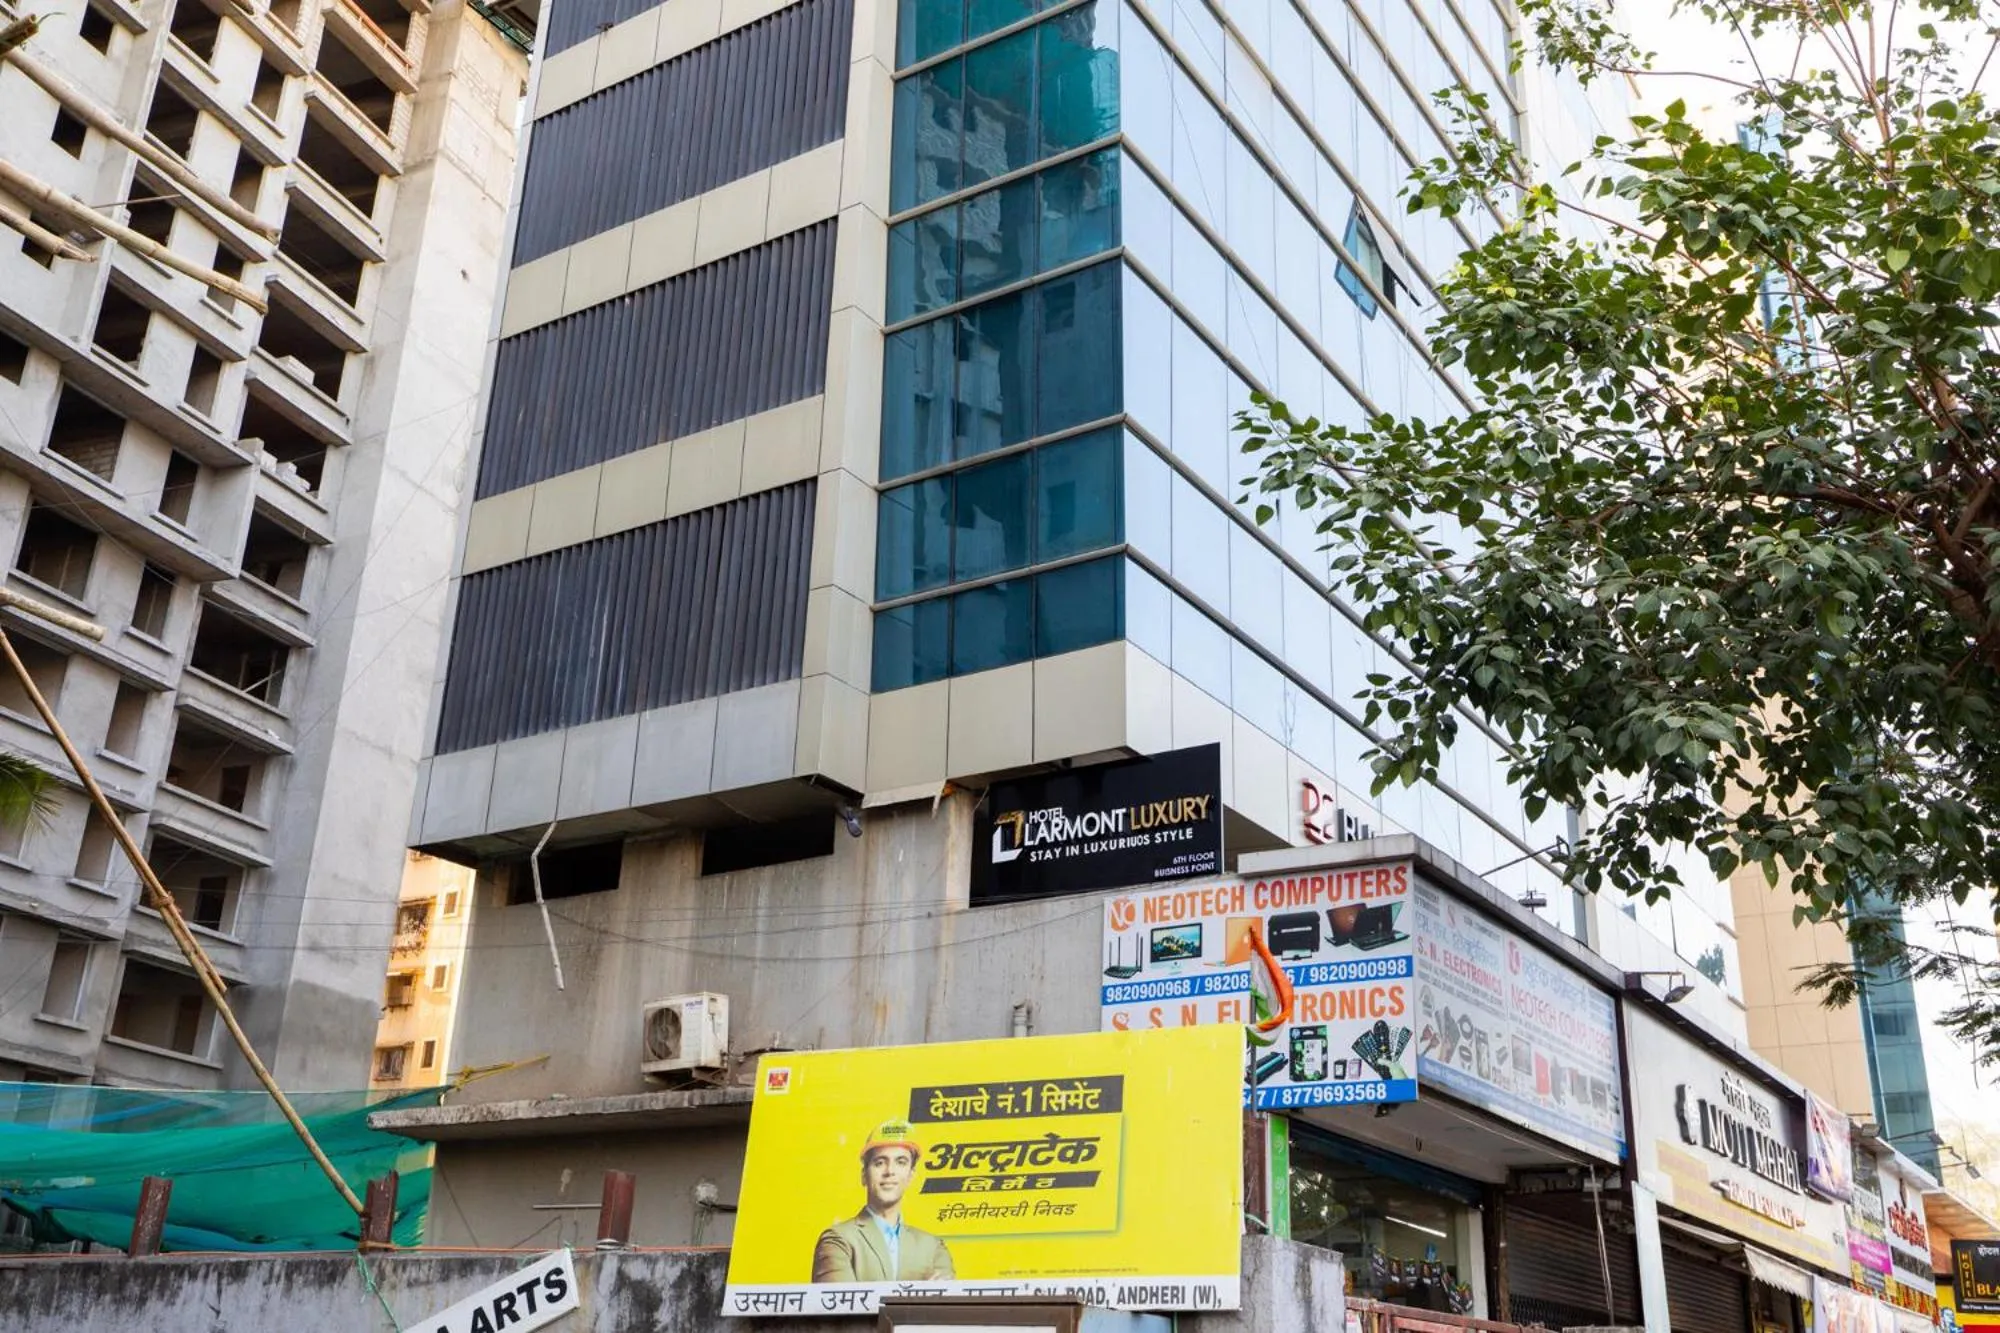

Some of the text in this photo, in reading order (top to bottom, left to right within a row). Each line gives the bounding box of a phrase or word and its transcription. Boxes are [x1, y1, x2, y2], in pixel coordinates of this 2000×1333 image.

[1024, 794, 1210, 846] LARMONT LUXURY
[1029, 807, 1066, 825] HOTEL
[1030, 848, 1061, 862] STAY
[1066, 845, 1080, 856] IN
[1155, 827, 1193, 844] STYLE
[1189, 851, 1215, 862] FLOOR
[1191, 862, 1215, 872] POINT
[1143, 885, 1245, 924] NEOTECH
[1254, 865, 1408, 910] COMPUTERS
[1106, 977, 1190, 1003] 9820900968
[1310, 959, 1407, 983] 9820900998
[1443, 949, 1503, 997] ELECTRONICS
[929, 1087, 990, 1118] देशाचे
[1041, 1081, 1102, 1112] सिमेंट
[1282, 1083, 1387, 1105] 8779693568
[924, 1131, 1101, 1173] अल्ट्राटेक
[1033, 1200, 1078, 1217] निवड
[470, 1266, 568, 1333] ARTS
[734, 1291, 808, 1313] उस्मान
[820, 1289, 875, 1311] उमर
[1117, 1285, 1186, 1305] ANDHERI
[1192, 1284, 1222, 1309] (W),
